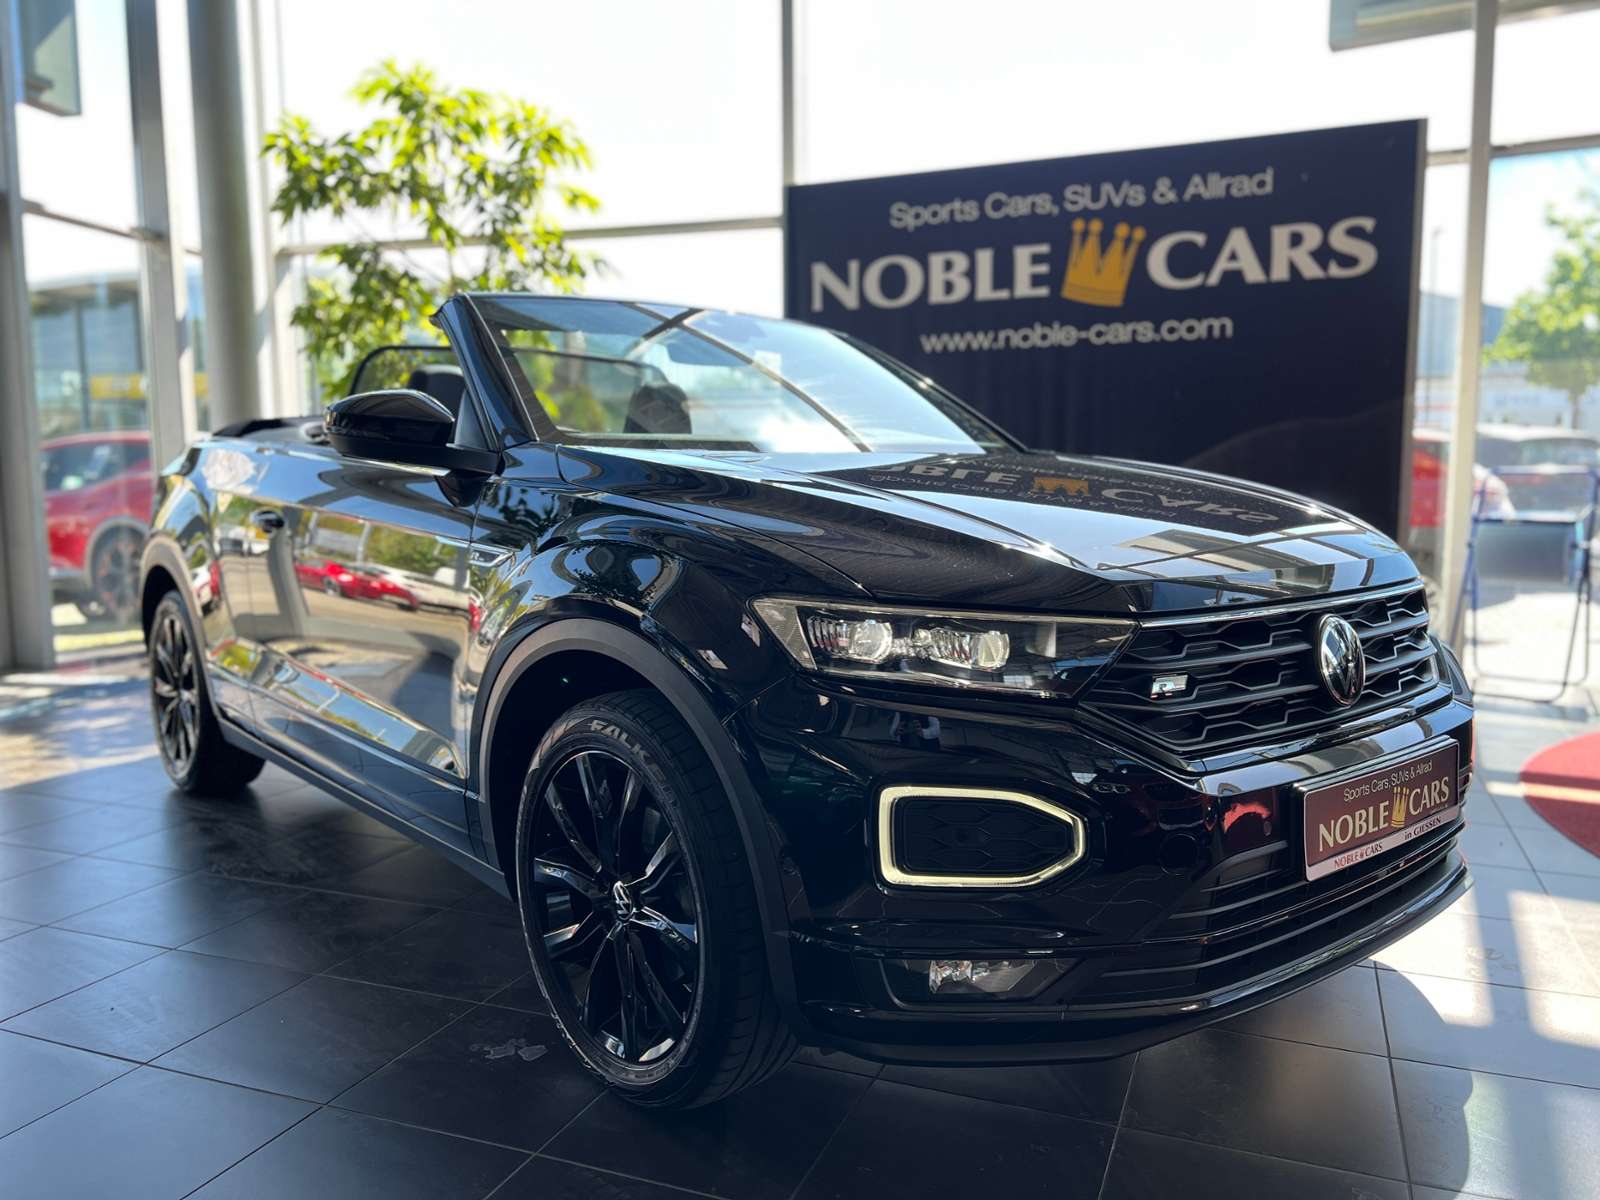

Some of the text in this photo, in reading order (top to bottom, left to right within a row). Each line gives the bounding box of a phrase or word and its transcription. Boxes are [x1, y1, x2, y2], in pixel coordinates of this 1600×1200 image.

[889, 166, 1275, 232] Sports Cars, SUVs & Allrad
[810, 215, 1379, 313] NOBLE CARS
[920, 315, 1234, 354] www.noble-cars.com
[1343, 784, 1370, 802] Sports
[1391, 769, 1409, 786] SUVs
[1409, 767, 1416, 779] &
[1319, 777, 1449, 851] NOBLE CARS
[1404, 816, 1442, 840] in GIESSEN
[1333, 842, 1383, 869] NOBLE CARS
